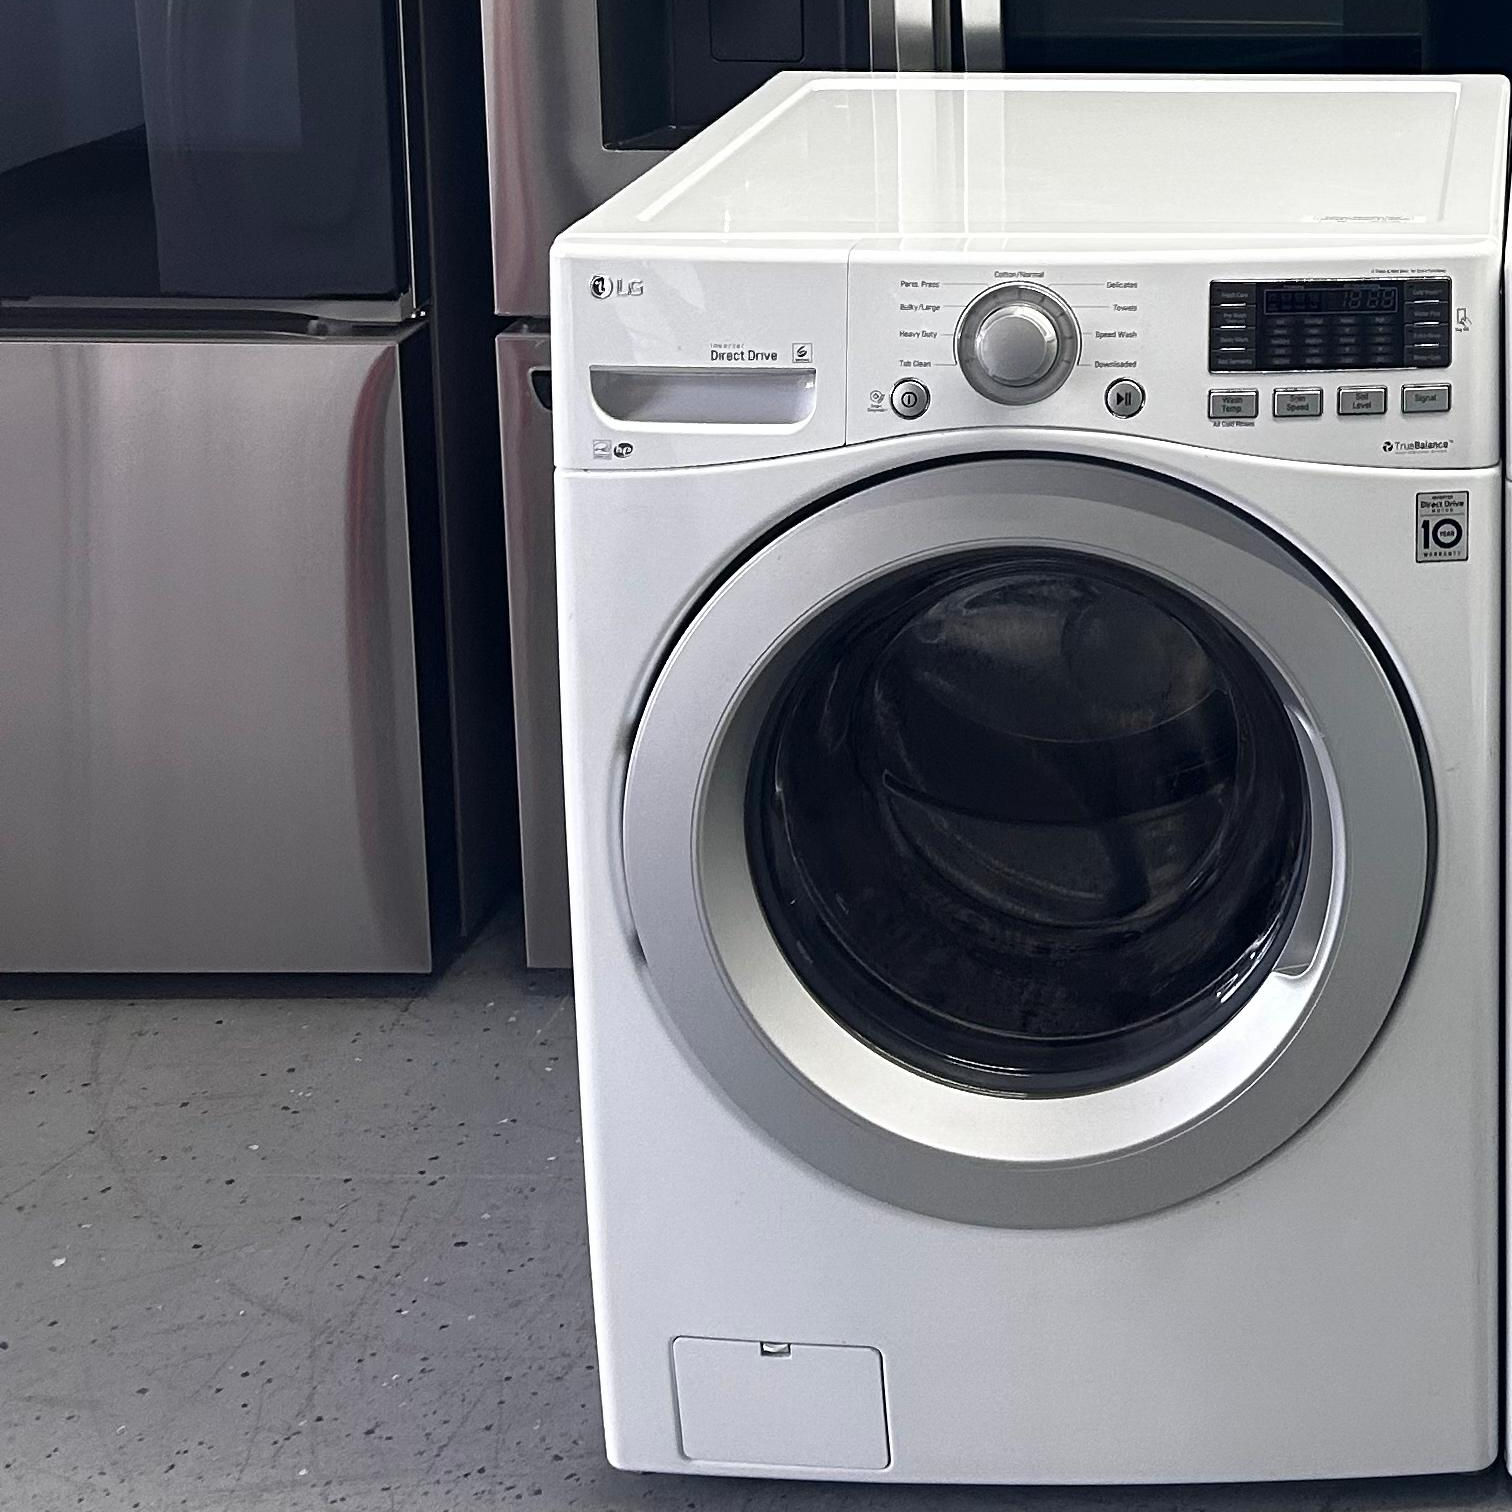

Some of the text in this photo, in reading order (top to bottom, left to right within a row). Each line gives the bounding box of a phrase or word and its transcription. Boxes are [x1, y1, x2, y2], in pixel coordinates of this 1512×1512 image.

[616, 278, 644, 296] LG
[900, 330, 938, 338] Heavy Duty
[1118, 330, 1138, 338] Wash
[710, 350, 778, 362] Direct Drive
[914, 360, 932, 368] Clean
[1414, 394, 1437, 404] Signal
[1286, 402, 1310, 412] Speed
[1352, 400, 1372, 410] Level
[1421, 518, 1463, 550] 10
